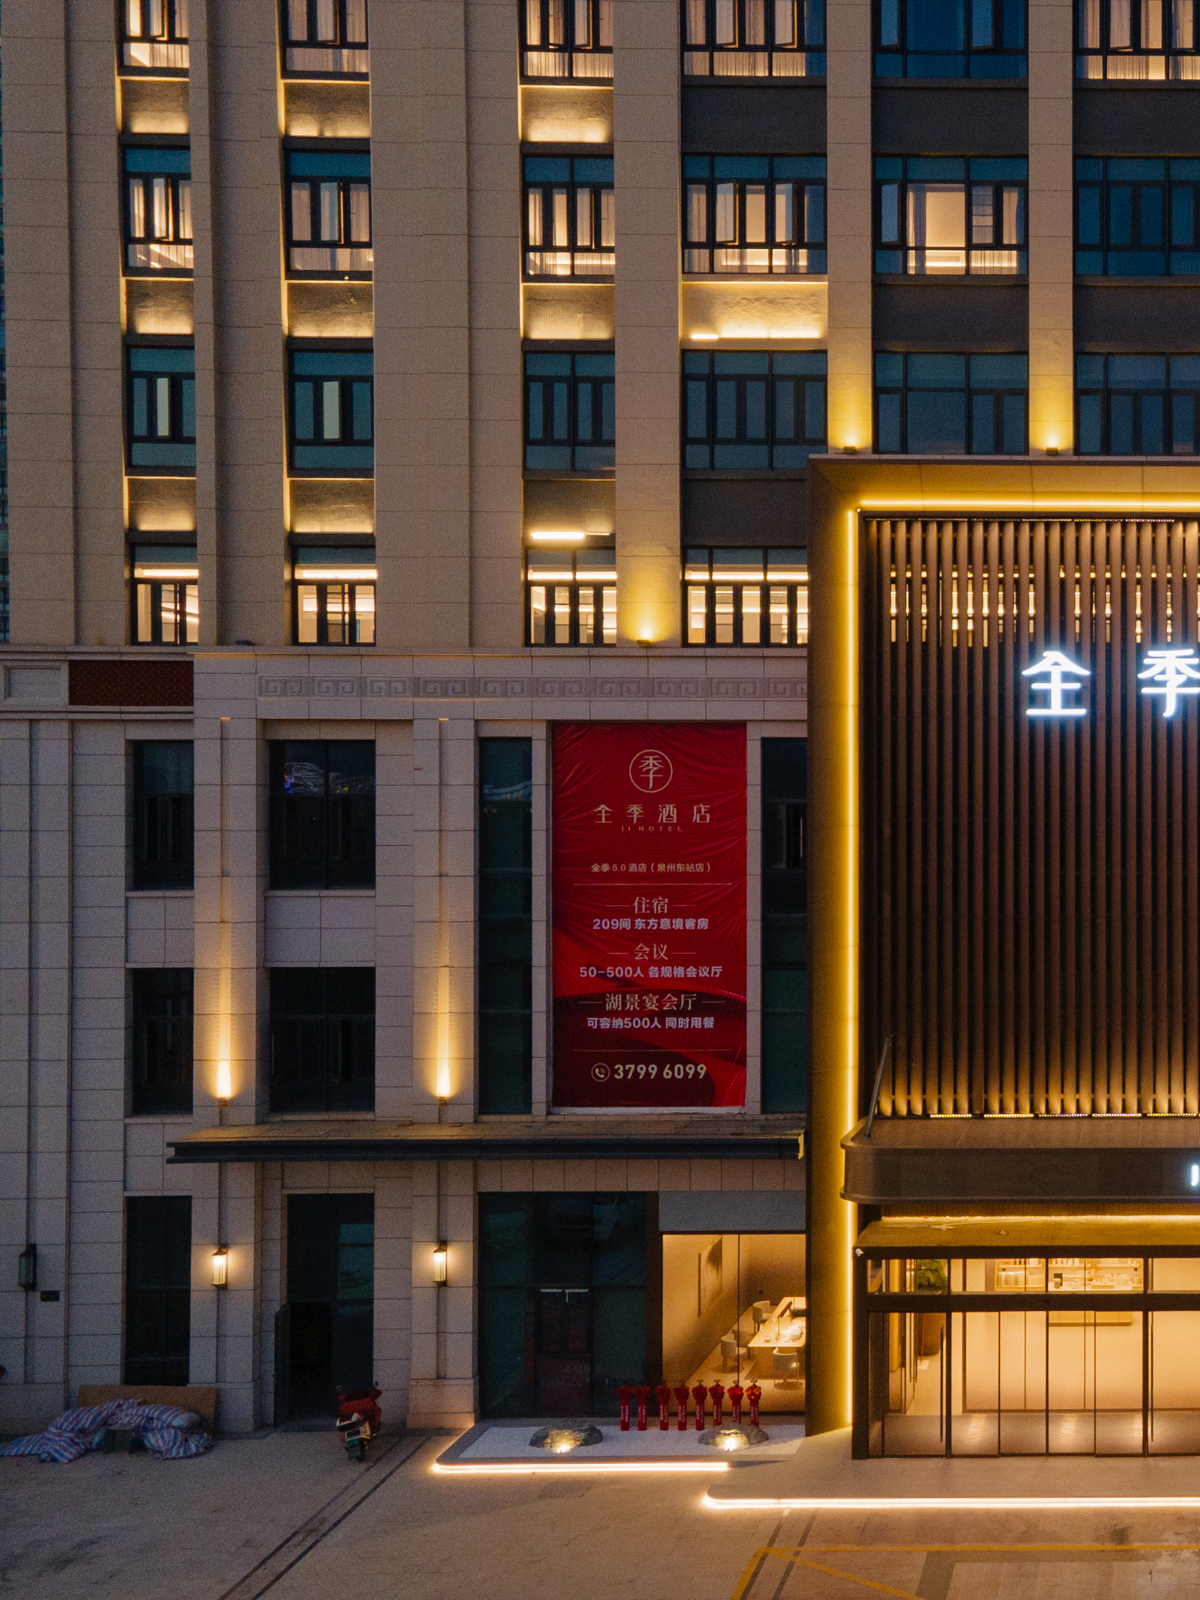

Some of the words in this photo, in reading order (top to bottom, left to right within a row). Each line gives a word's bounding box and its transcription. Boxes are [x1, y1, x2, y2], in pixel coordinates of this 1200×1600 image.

[593, 803, 712, 824] 全季酒店
[633, 896, 669, 914] 住宿
[592, 918, 632, 930] 209间
[634, 918, 709, 930] 东方意境客房
[634, 943, 669, 961] 会议
[579, 966, 645, 978] 50-500人
[647, 965, 723, 978] 各规格会议厅
[605, 993, 698, 1011] 湖景宴会厅
[586, 1017, 662, 1029] 可容纳500人
[665, 1017, 715, 1029] 同时用餐
[614, 1064, 658, 1080] 3799
[662, 1064, 706, 1080] 6099
